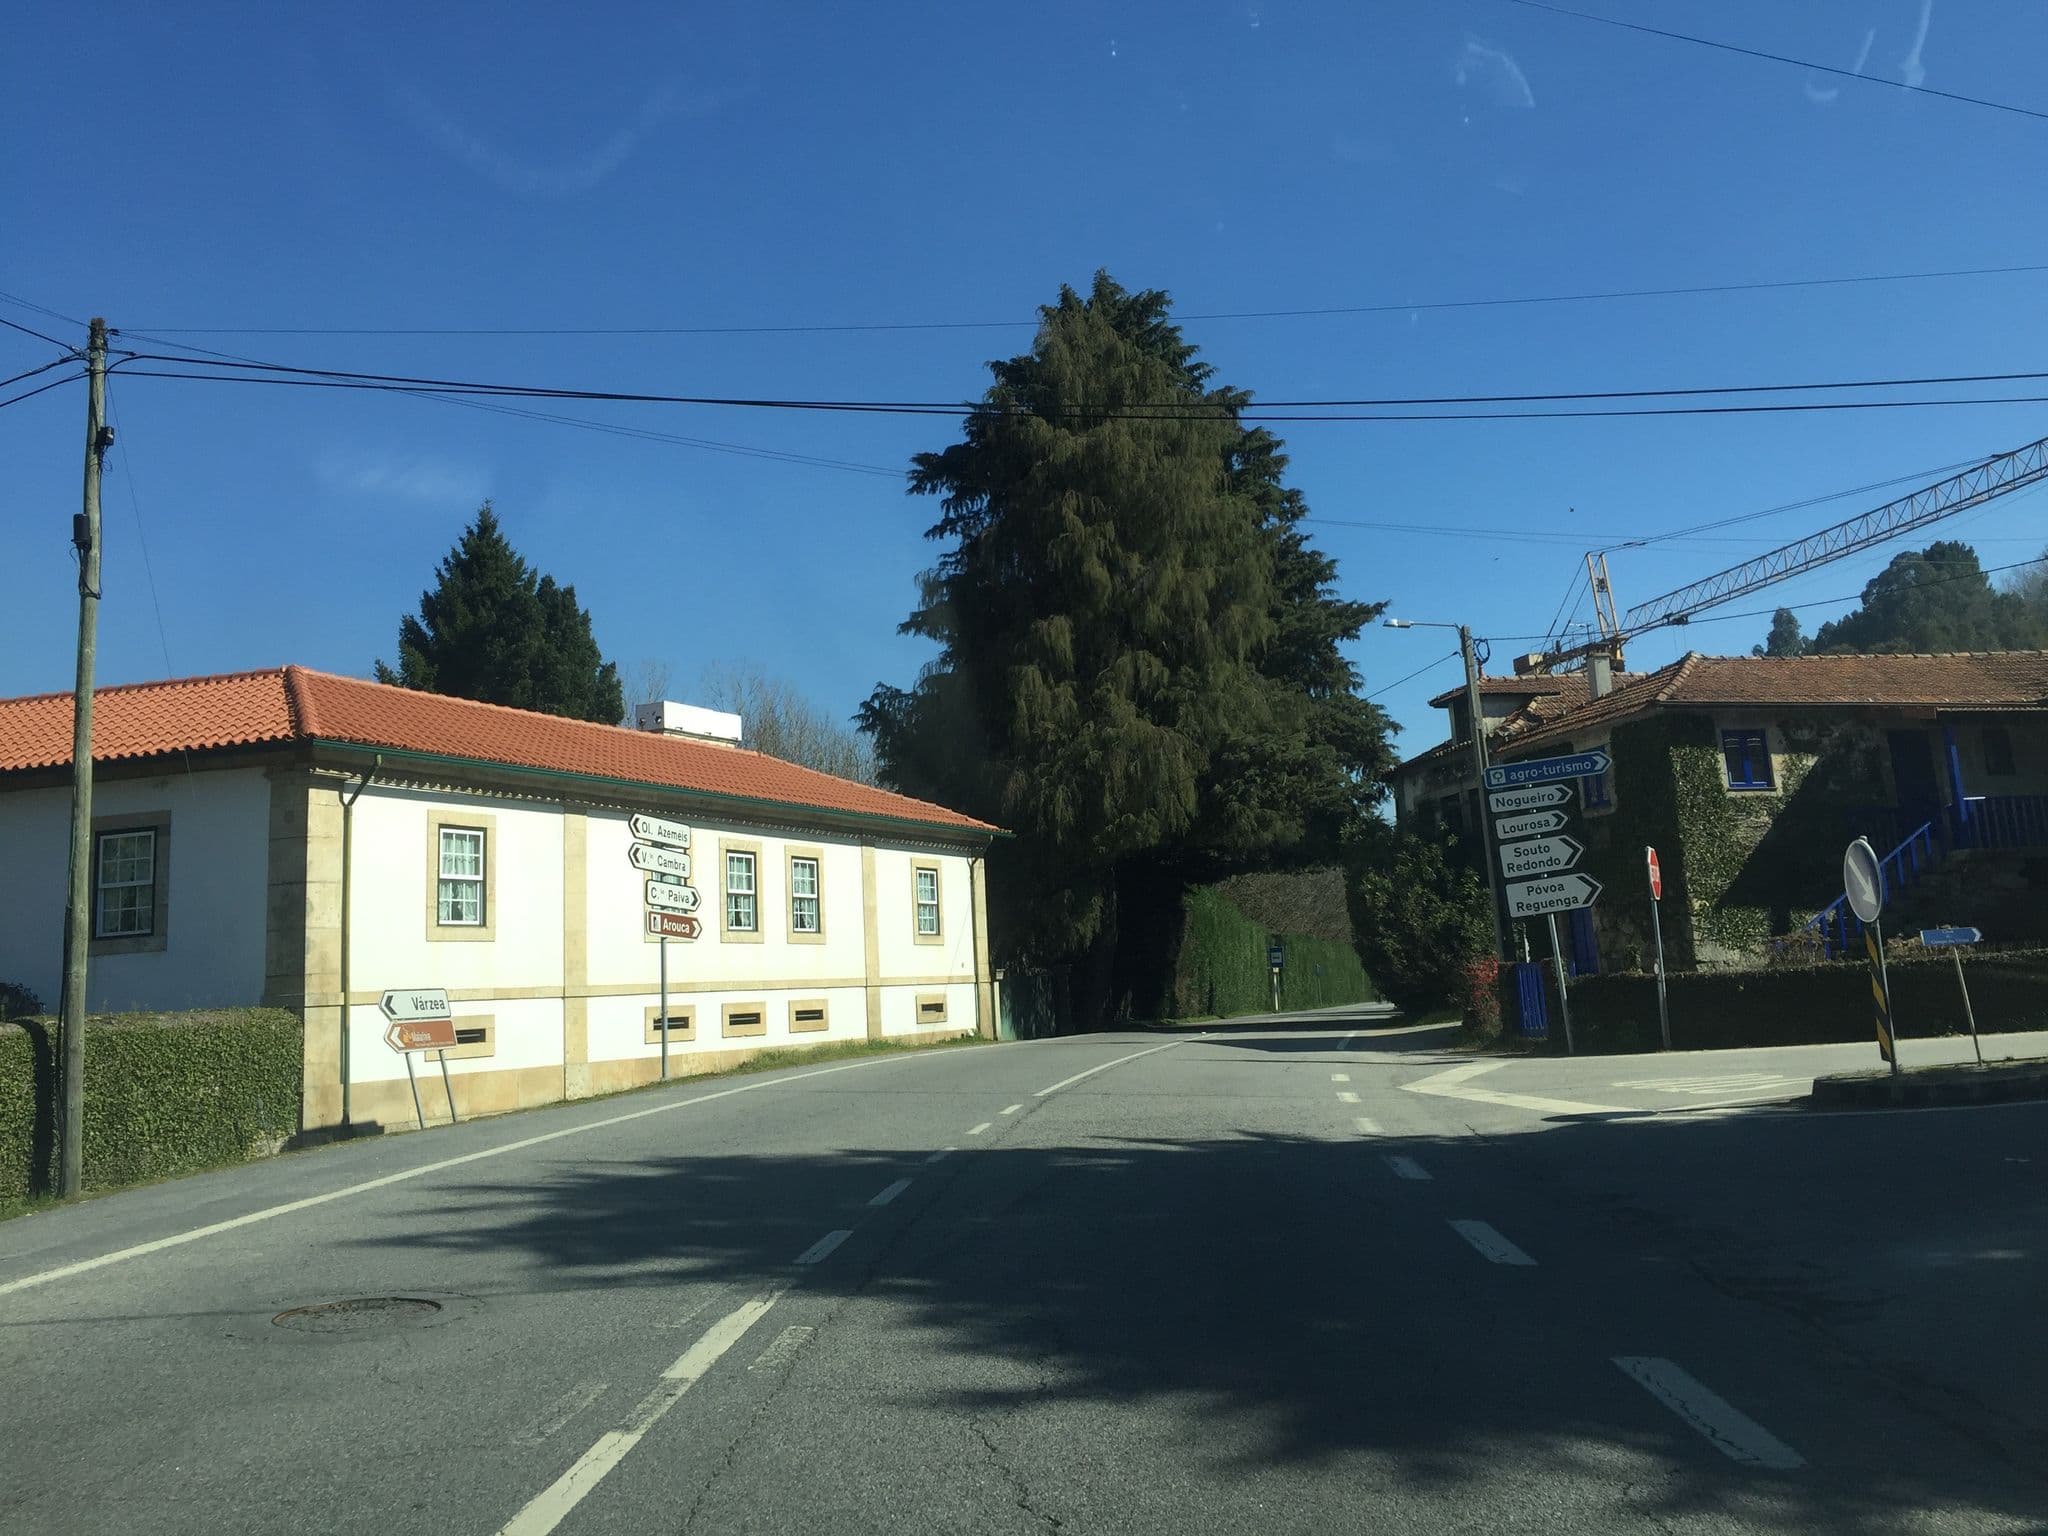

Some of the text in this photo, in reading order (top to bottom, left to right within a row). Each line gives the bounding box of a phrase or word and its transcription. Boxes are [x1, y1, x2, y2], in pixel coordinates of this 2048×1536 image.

[1510, 761, 1592, 781] agro-turismo
[1495, 792, 1555, 809] Nogueiro
[1502, 819, 1551, 835] Lourosa
[1513, 844, 1551, 858] Souto
[657, 855, 687, 872] Cambra
[1506, 856, 1561, 873] Redondo
[668, 889, 690, 904] Paiva
[1526, 883, 1566, 896] Póvoa
[1516, 896, 1579, 912] Reguenga
[662, 917, 690, 934] Arouca
[411, 996, 446, 1011] Várzea
